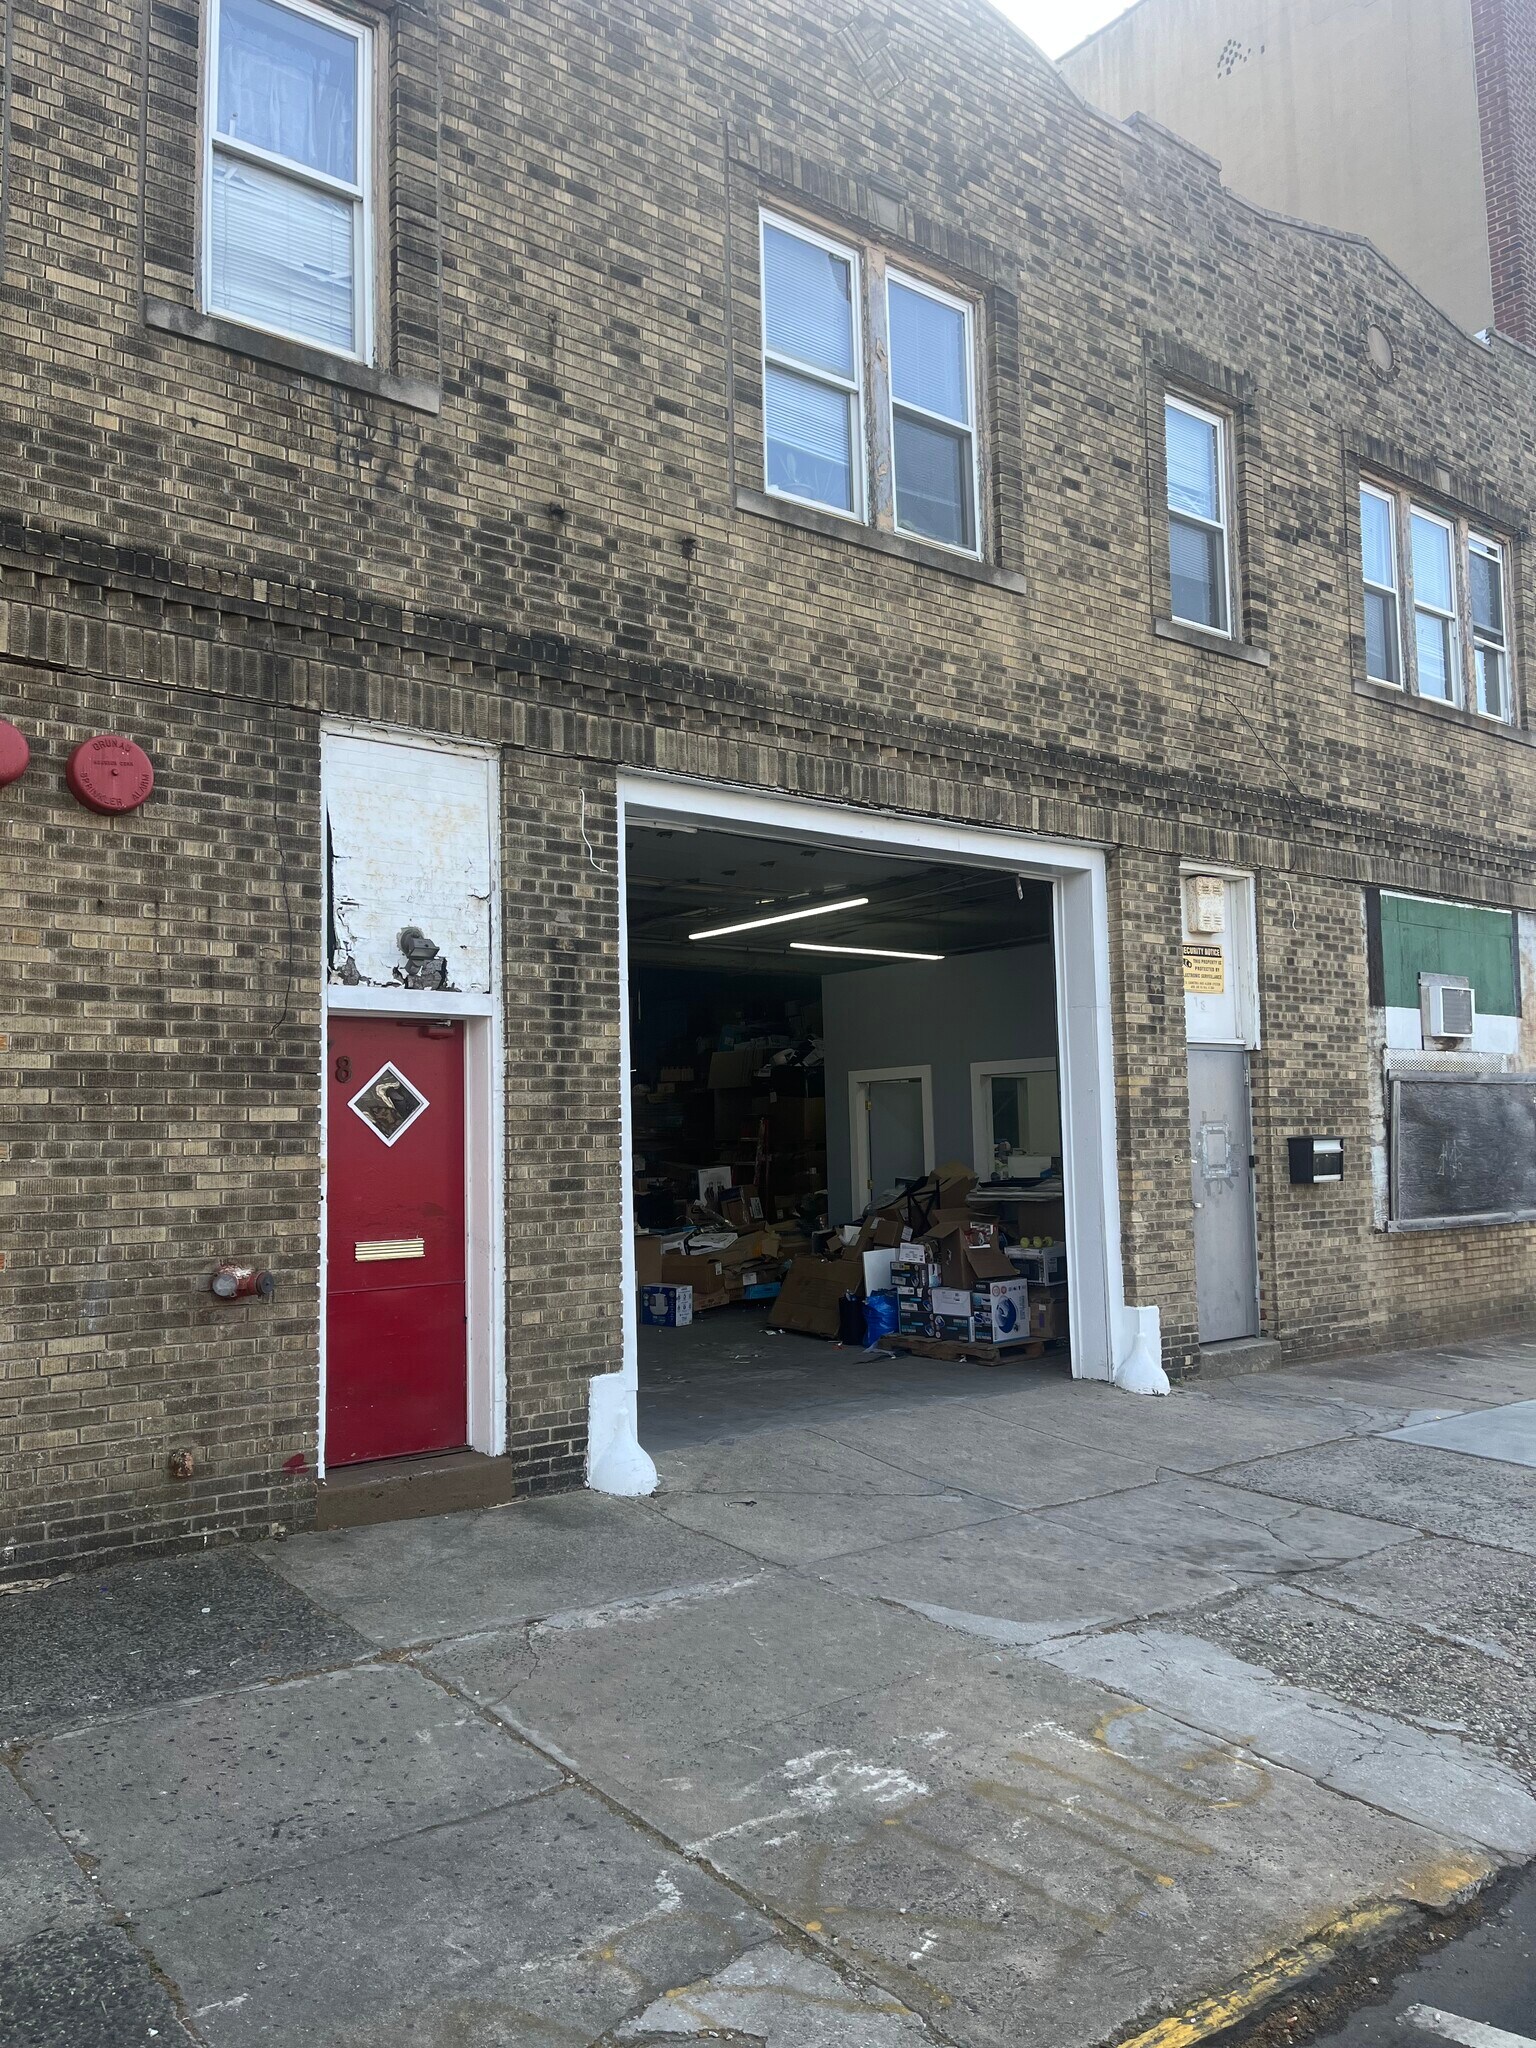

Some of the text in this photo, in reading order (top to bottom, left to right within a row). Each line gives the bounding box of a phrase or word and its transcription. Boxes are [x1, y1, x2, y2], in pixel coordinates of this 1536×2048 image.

[92, 738, 132, 752] GRUNAU
[80, 771, 150, 806] SPRINKLER ALARM
[1184, 947, 1220, 956] ECURITY NOTICE
[335, 1055, 352, 1083] 8
